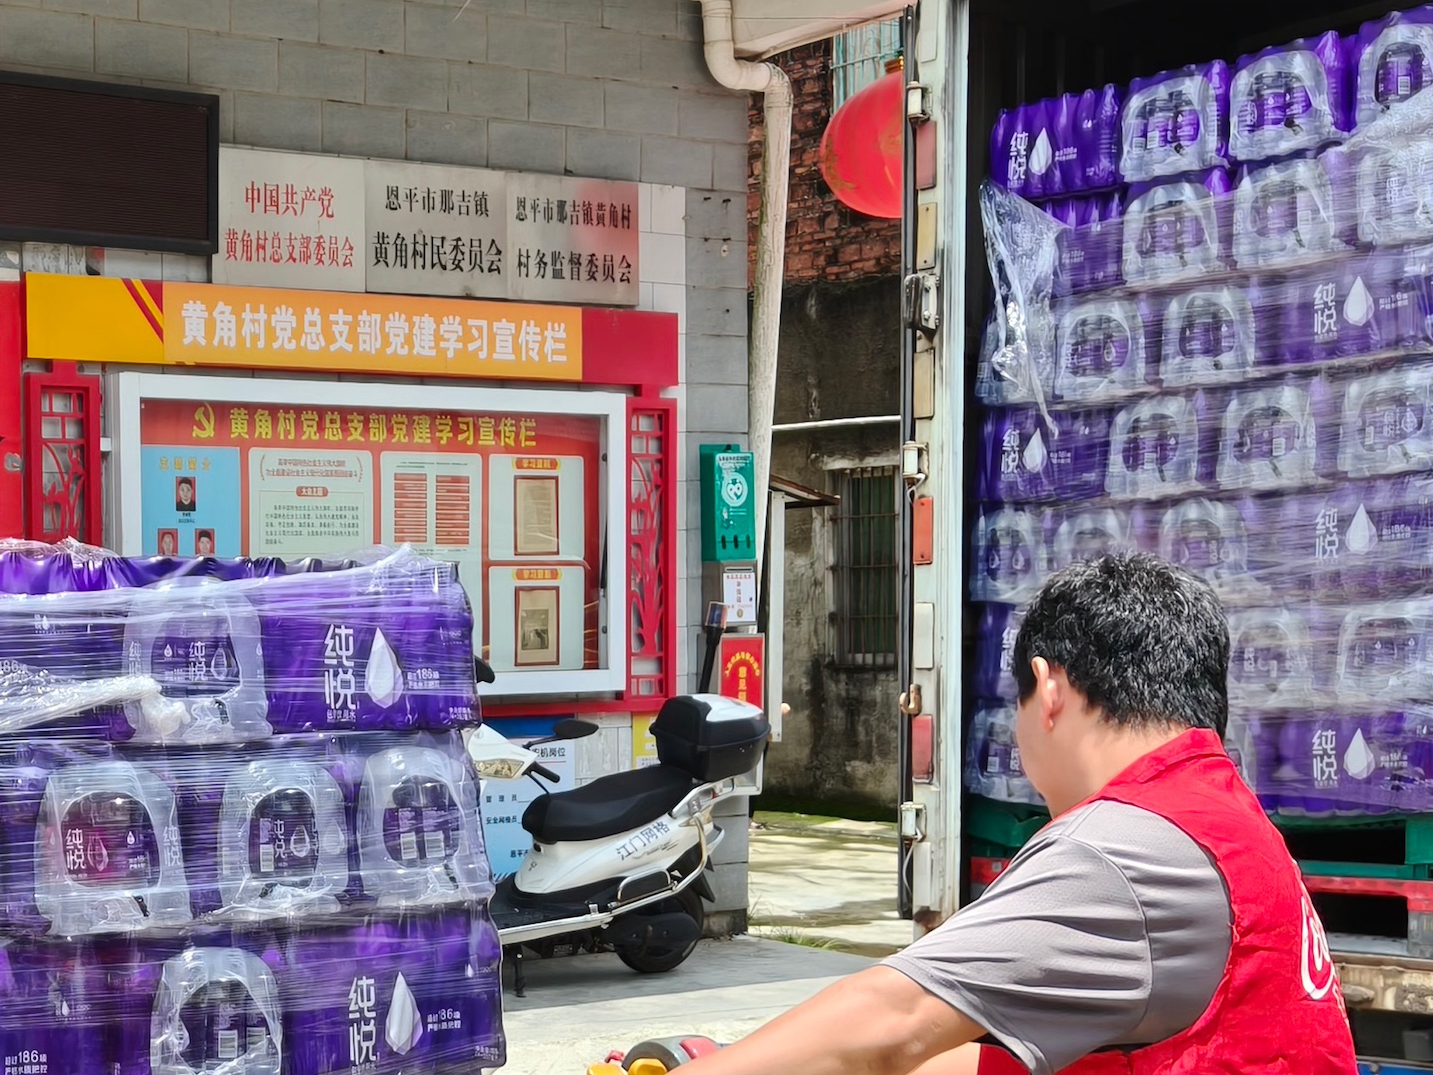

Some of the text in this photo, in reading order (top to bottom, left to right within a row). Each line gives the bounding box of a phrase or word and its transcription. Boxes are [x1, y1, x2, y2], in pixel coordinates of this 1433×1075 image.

[245, 181, 334, 219] 中国共产党
[385, 184, 490, 218] 恩平市那吉镇
[516, 196, 633, 230] 恩平市那吉镇黄角村
[224, 228, 354, 268] 黄角村总支部委员会
[372, 231, 502, 275] 黄角村民委员会
[516, 247, 633, 284] 村务监督委员会
[1313, 282, 1337, 334] 纯悦
[181, 300, 567, 363] 黄角村党总支部党建学习宣传栏
[229, 407, 537, 447] 黄角村党总支部党建学习宣传栏
[1316, 507, 1339, 559] 纯悦
[189, 641, 208, 682] 纯悦
[324, 624, 356, 710] 纯悦
[1312, 730, 1338, 780] 纯悦
[66, 828, 87, 871] 纯悦
[617, 820, 671, 860] 江门网格
[348, 976, 377, 1066] 纯悦
